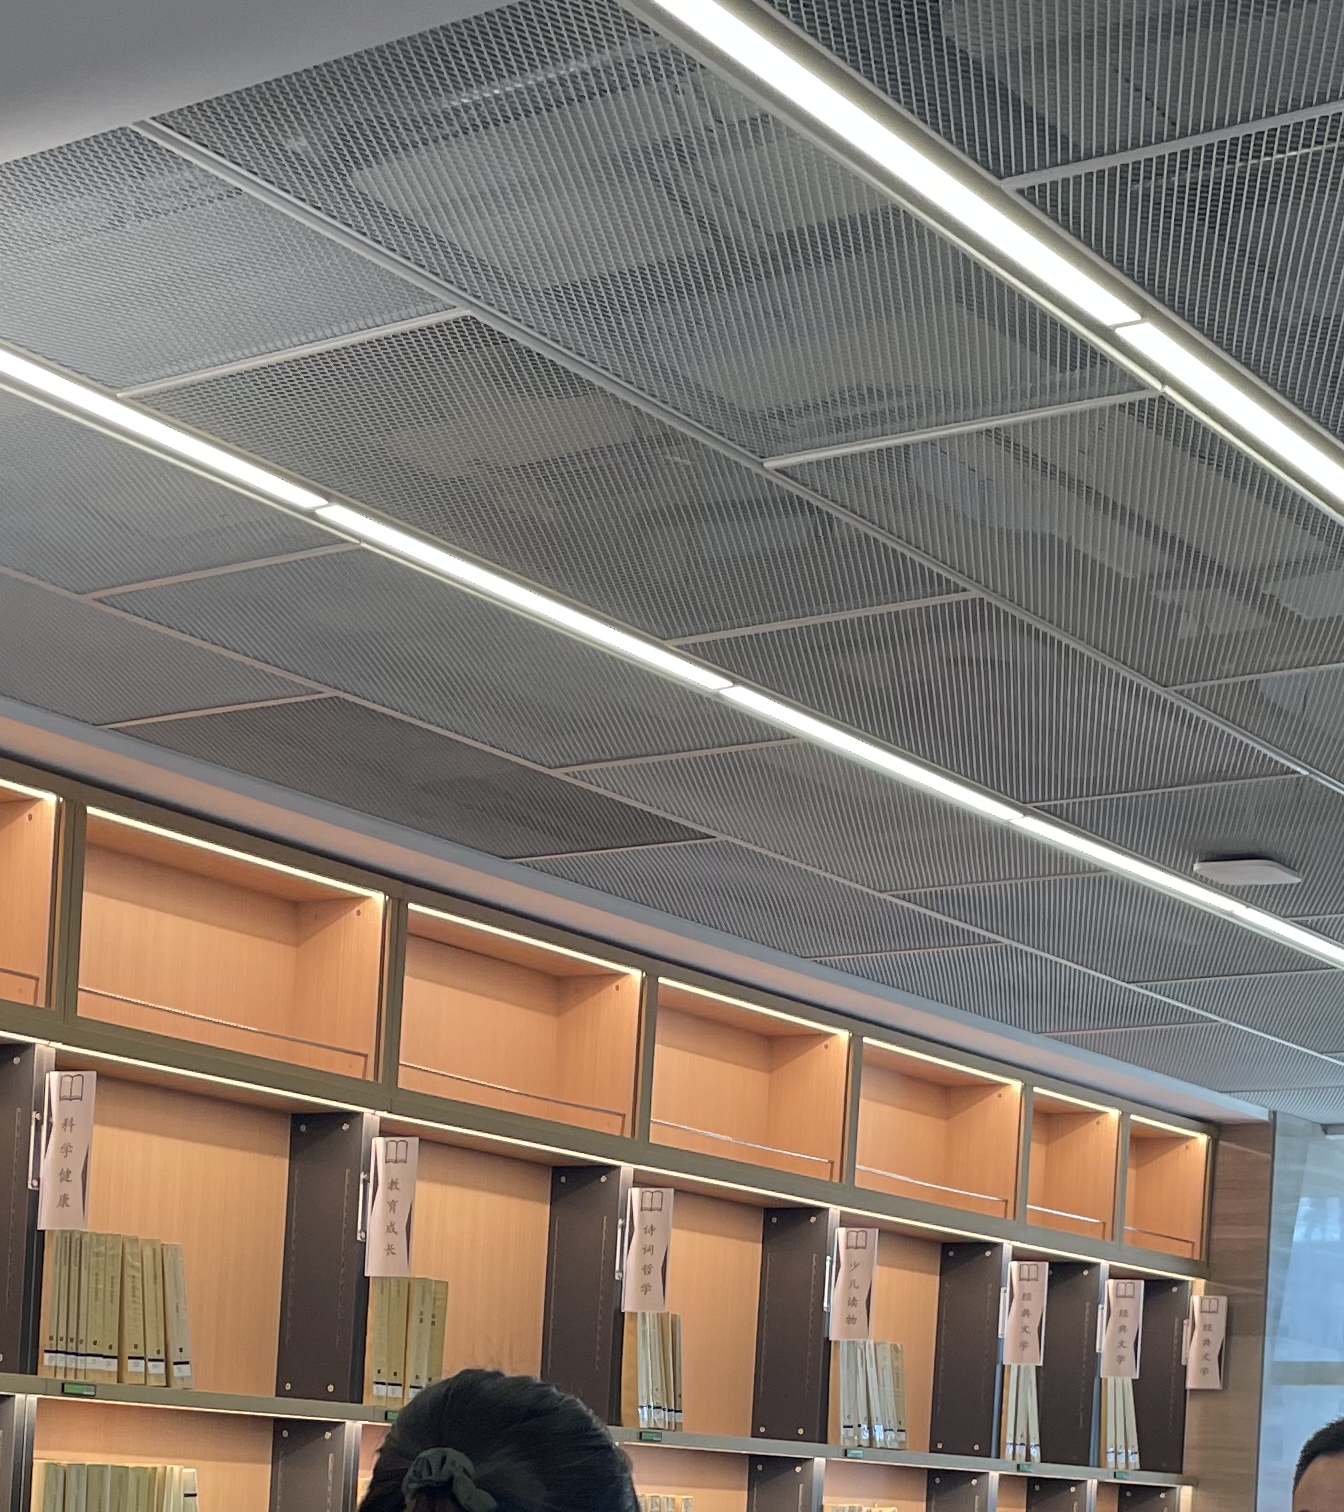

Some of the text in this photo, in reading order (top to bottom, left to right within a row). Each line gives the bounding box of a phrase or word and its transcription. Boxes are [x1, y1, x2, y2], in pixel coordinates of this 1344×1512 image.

[56, 1116, 76, 1209] 科学健康
[384, 1177, 401, 1256] 教育成长
[845, 1260, 860, 1326] 少儿读物
[1018, 1291, 1032, 1352] 经典文学
[1115, 1308, 1129, 1365] 经典文学
